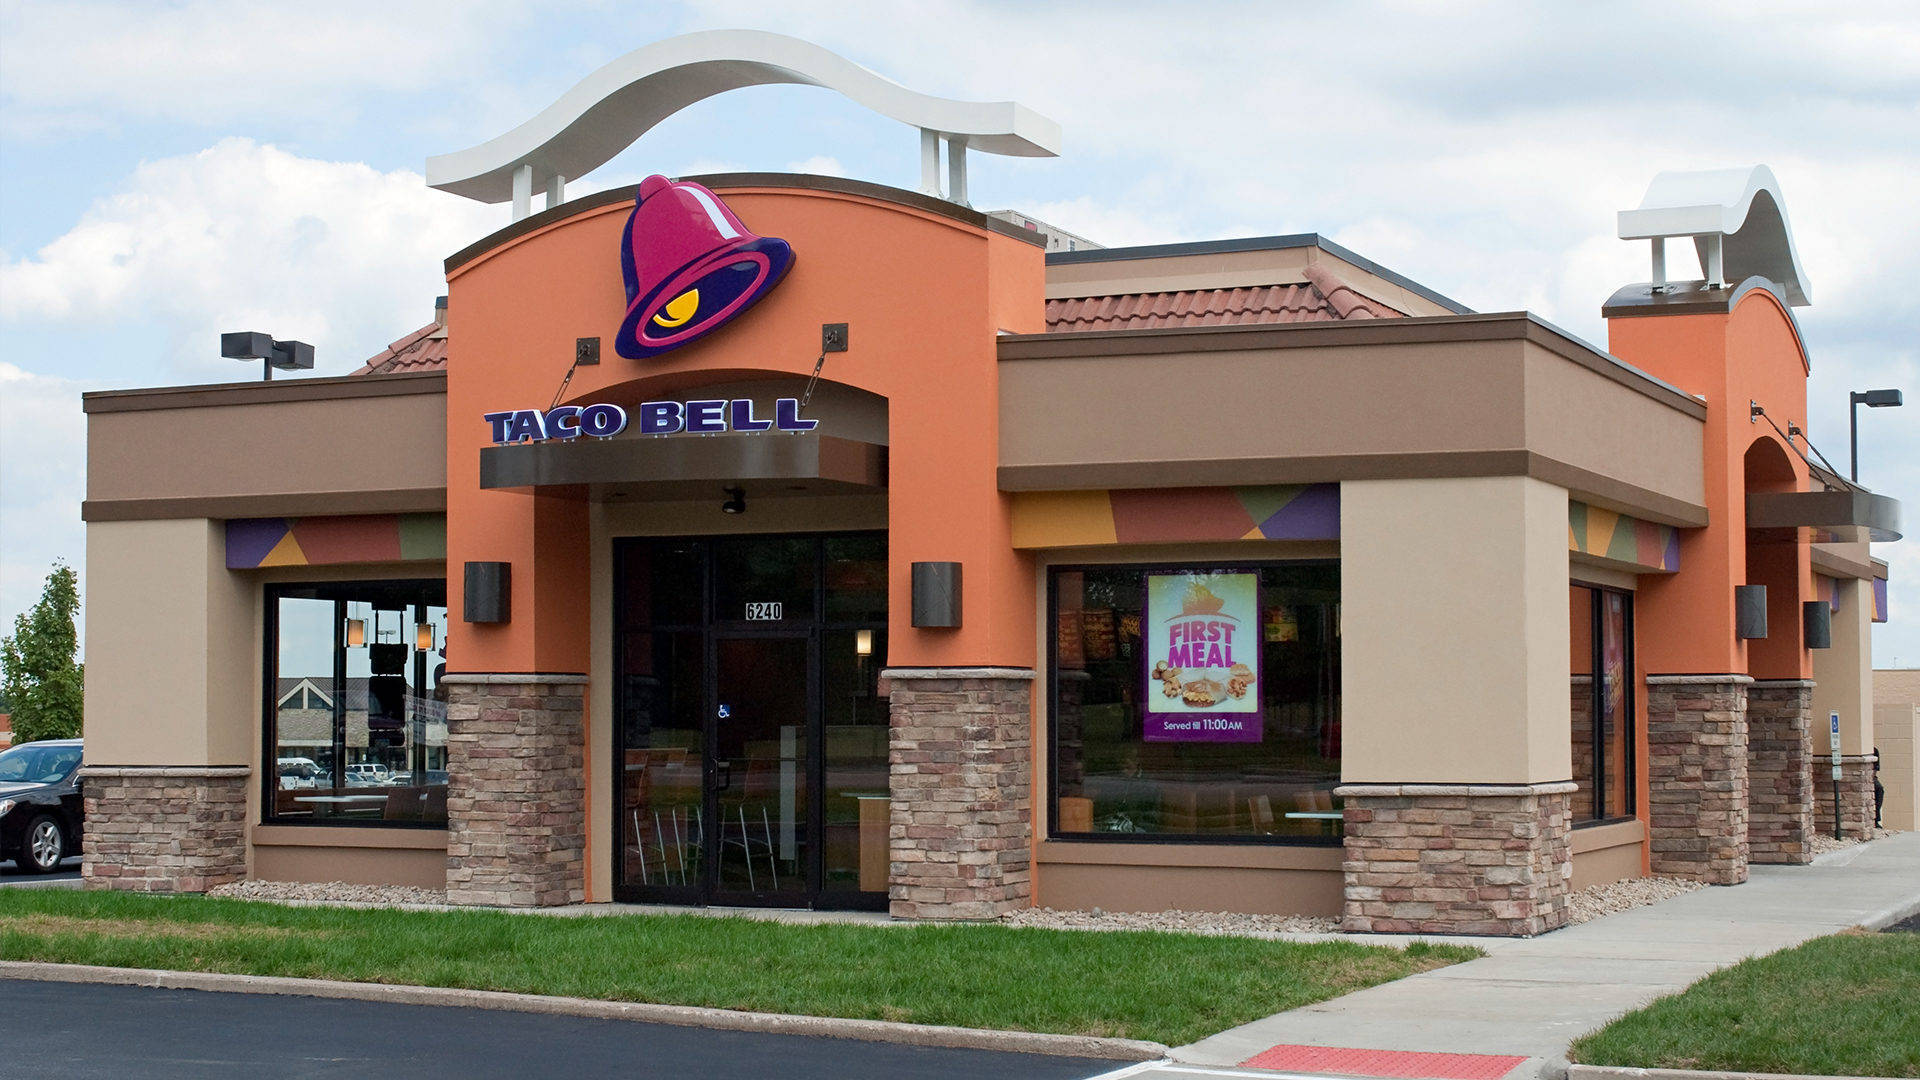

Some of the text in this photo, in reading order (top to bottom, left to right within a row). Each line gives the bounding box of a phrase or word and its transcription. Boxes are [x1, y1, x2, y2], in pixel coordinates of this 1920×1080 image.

[483, 397, 819, 443] TACO BELL
[747, 603, 781, 619] 6240
[1169, 620, 1236, 646] FIRST
[1168, 642, 1236, 669] MEAL
[1164, 721, 1191, 730] Served
